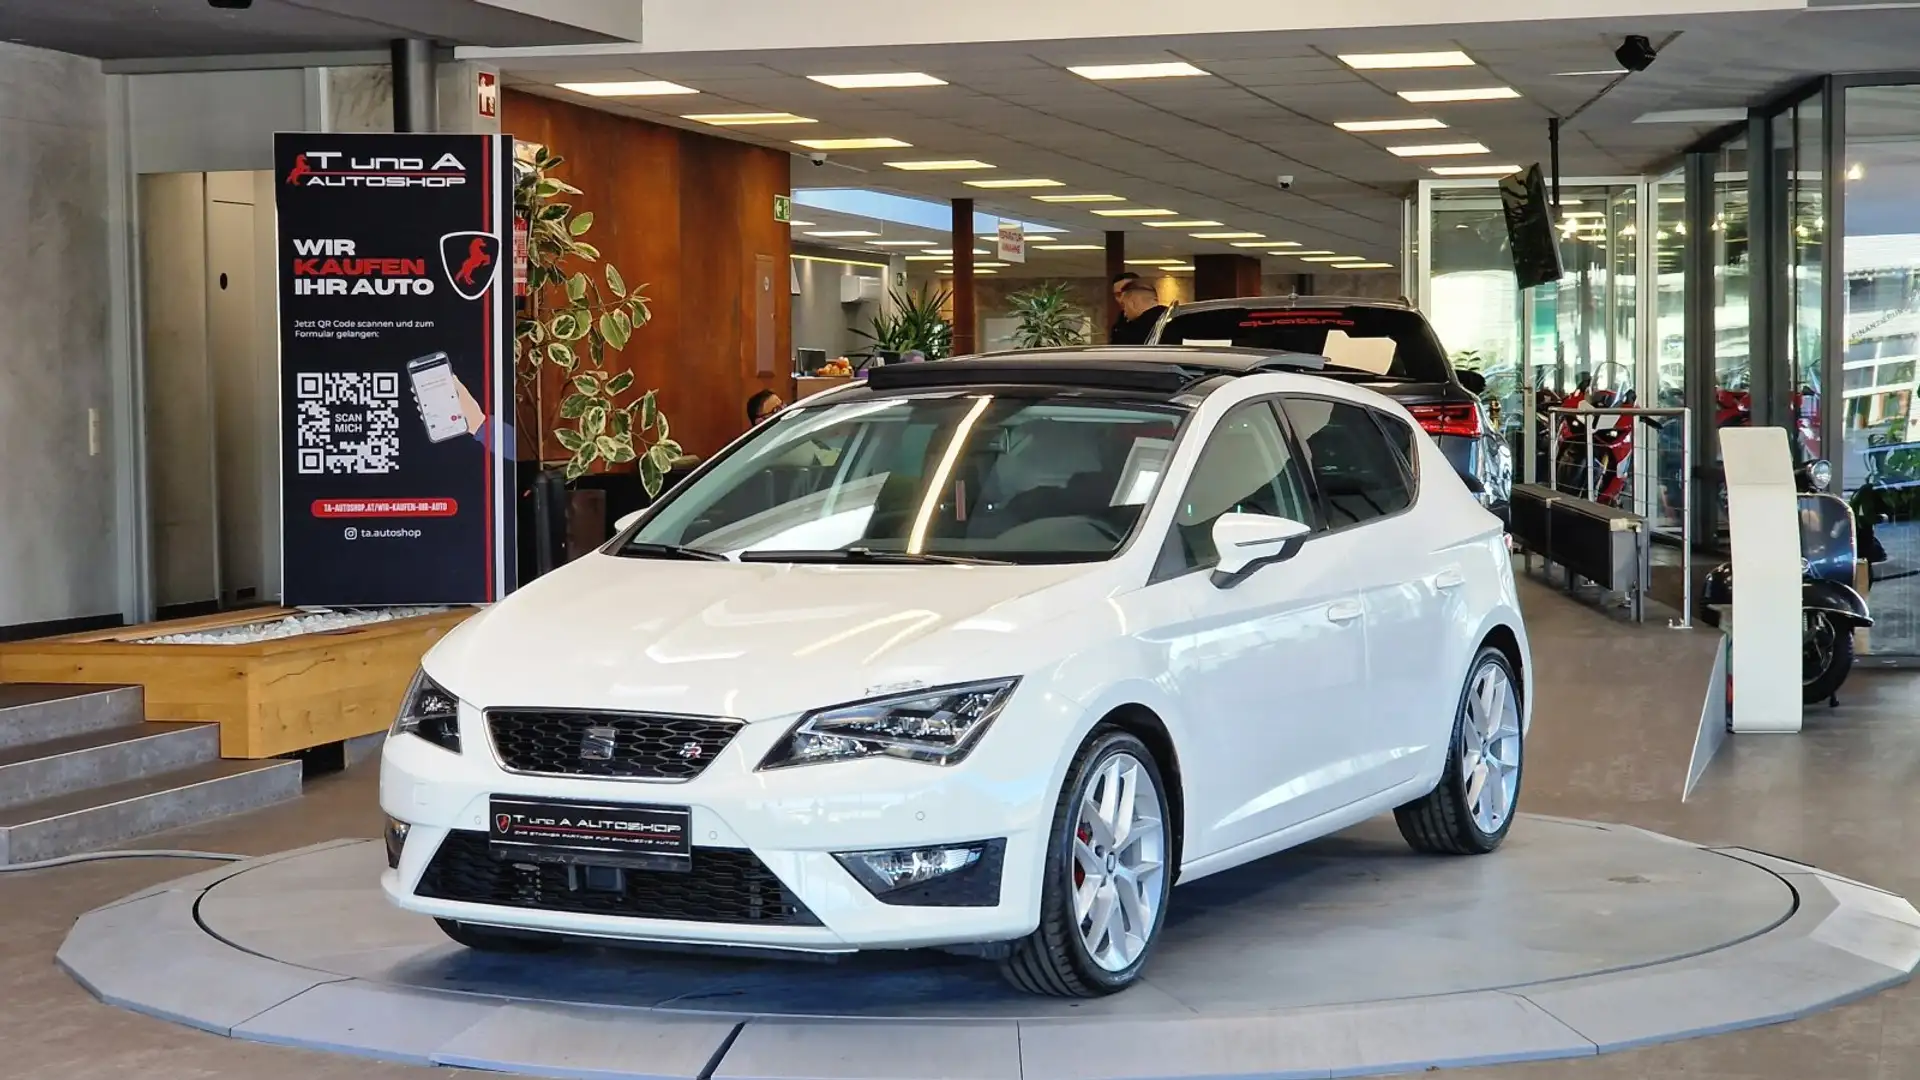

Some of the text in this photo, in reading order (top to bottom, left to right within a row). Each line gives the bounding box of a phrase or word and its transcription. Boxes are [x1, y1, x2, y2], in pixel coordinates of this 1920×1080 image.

[306, 151, 342, 170] T
[430, 153, 466, 170] A
[306, 176, 466, 187] AUTOSHOP
[293, 239, 356, 256] WIR
[293, 258, 425, 276] KAUFEN
[294, 279, 434, 295] IHR AUTO
[294, 320, 316, 328] Jetzt
[317, 320, 331, 329] QR
[333, 320, 356, 328] Code
[396, 320, 413, 328] und
[294, 330, 380, 340] Formular gelangen:
[334, 413, 363, 423] SCAN
[334, 423, 363, 433] MICH
[361, 528, 422, 538] ta.autoshop
[513, 814, 525, 823] T
[560, 818, 572, 826] A
[577, 819, 682, 833] AUTOSHOP
